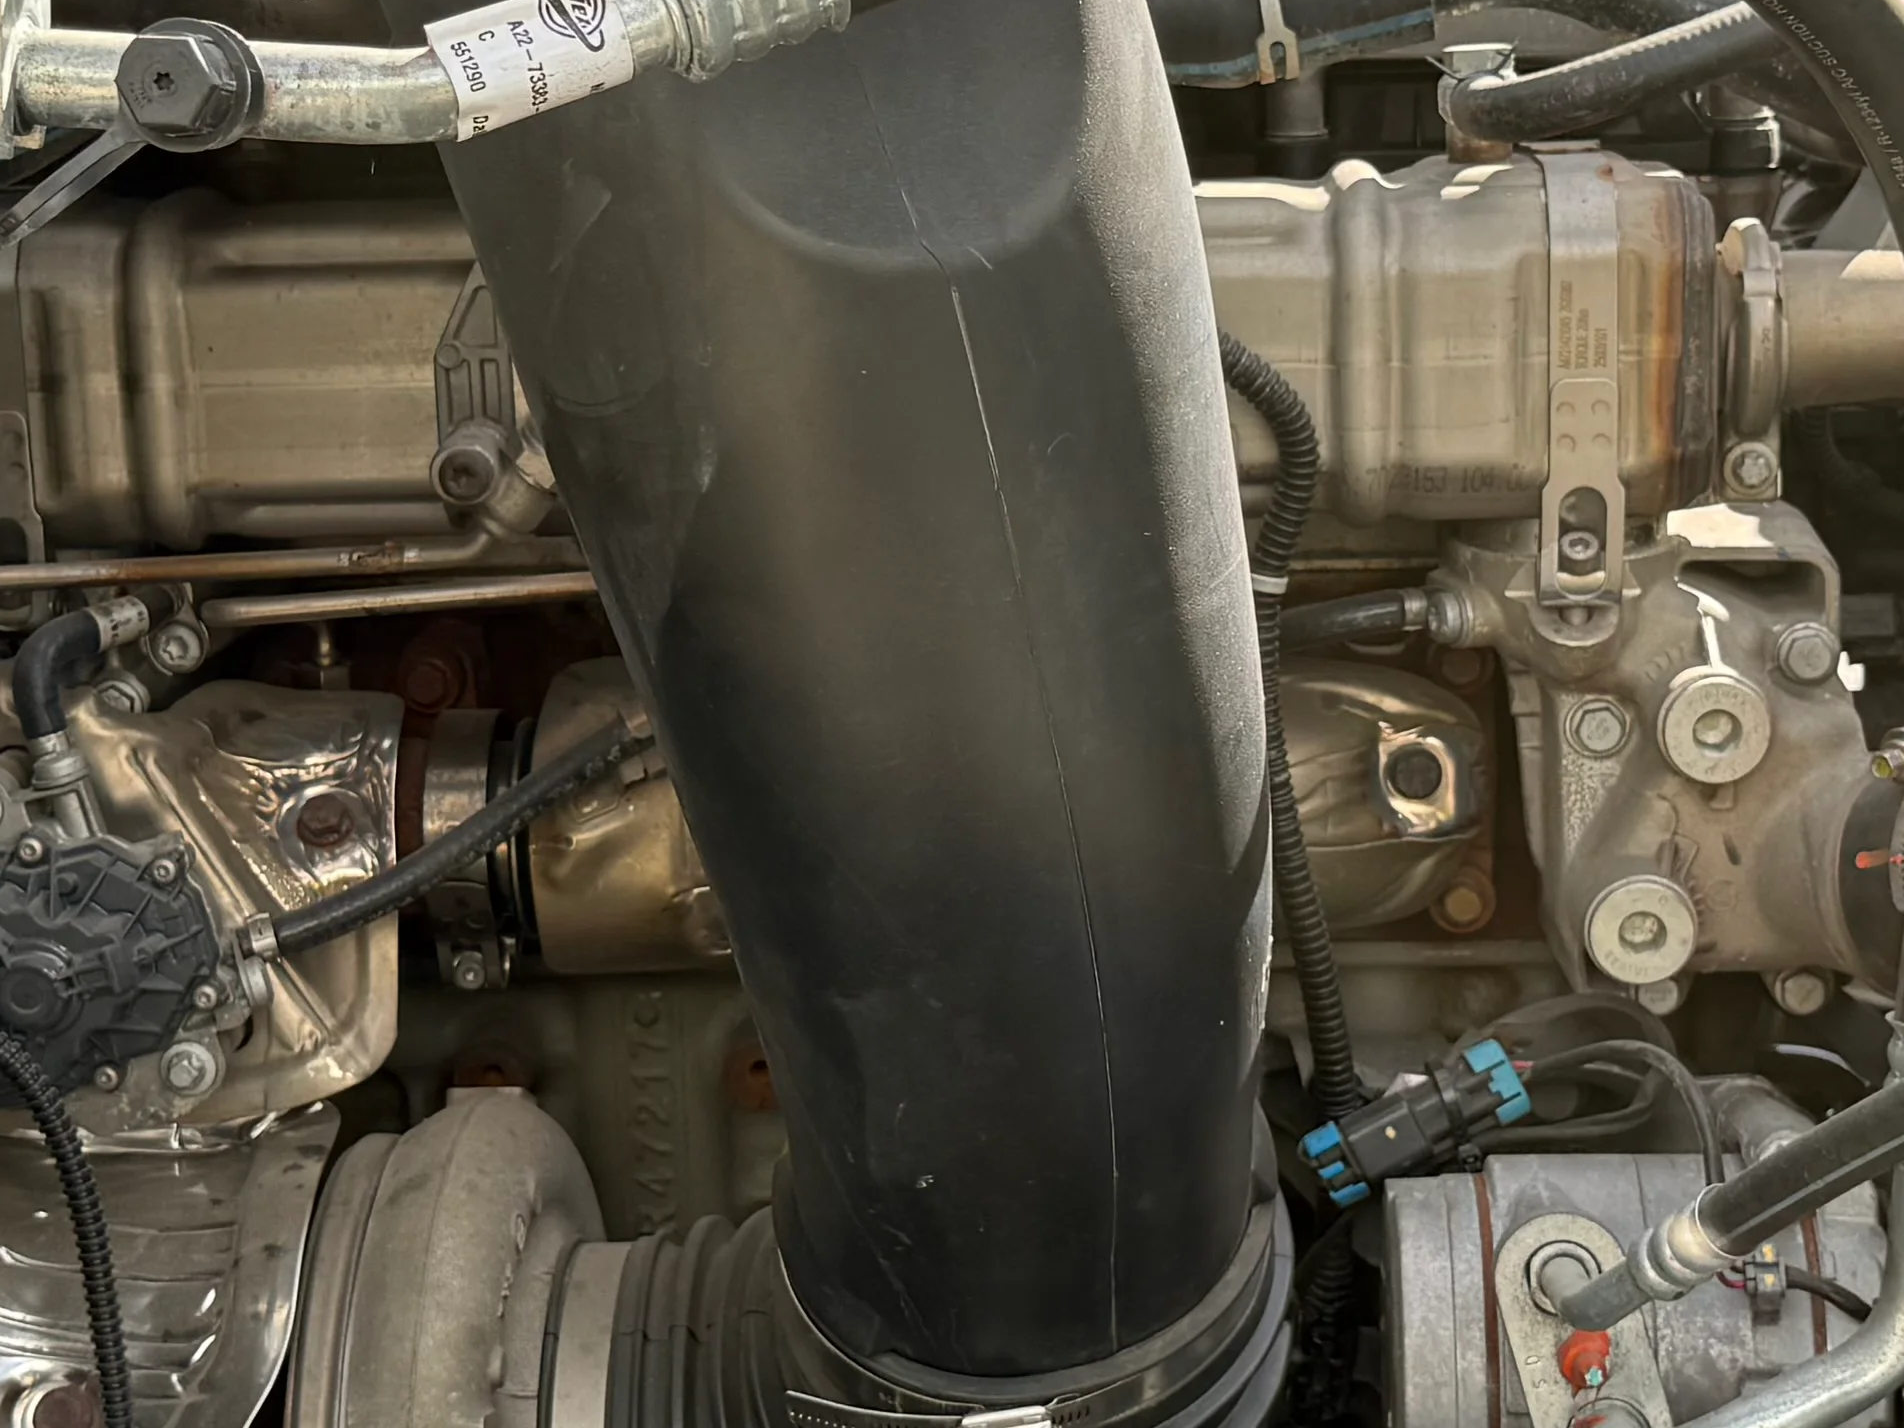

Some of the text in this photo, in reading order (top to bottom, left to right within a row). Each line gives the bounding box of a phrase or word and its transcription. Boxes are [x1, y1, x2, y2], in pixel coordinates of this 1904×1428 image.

[478, 30, 494, 42] C
[1783, 14, 1838, 67] SUCTION
[449, 40, 487, 93] 551290
